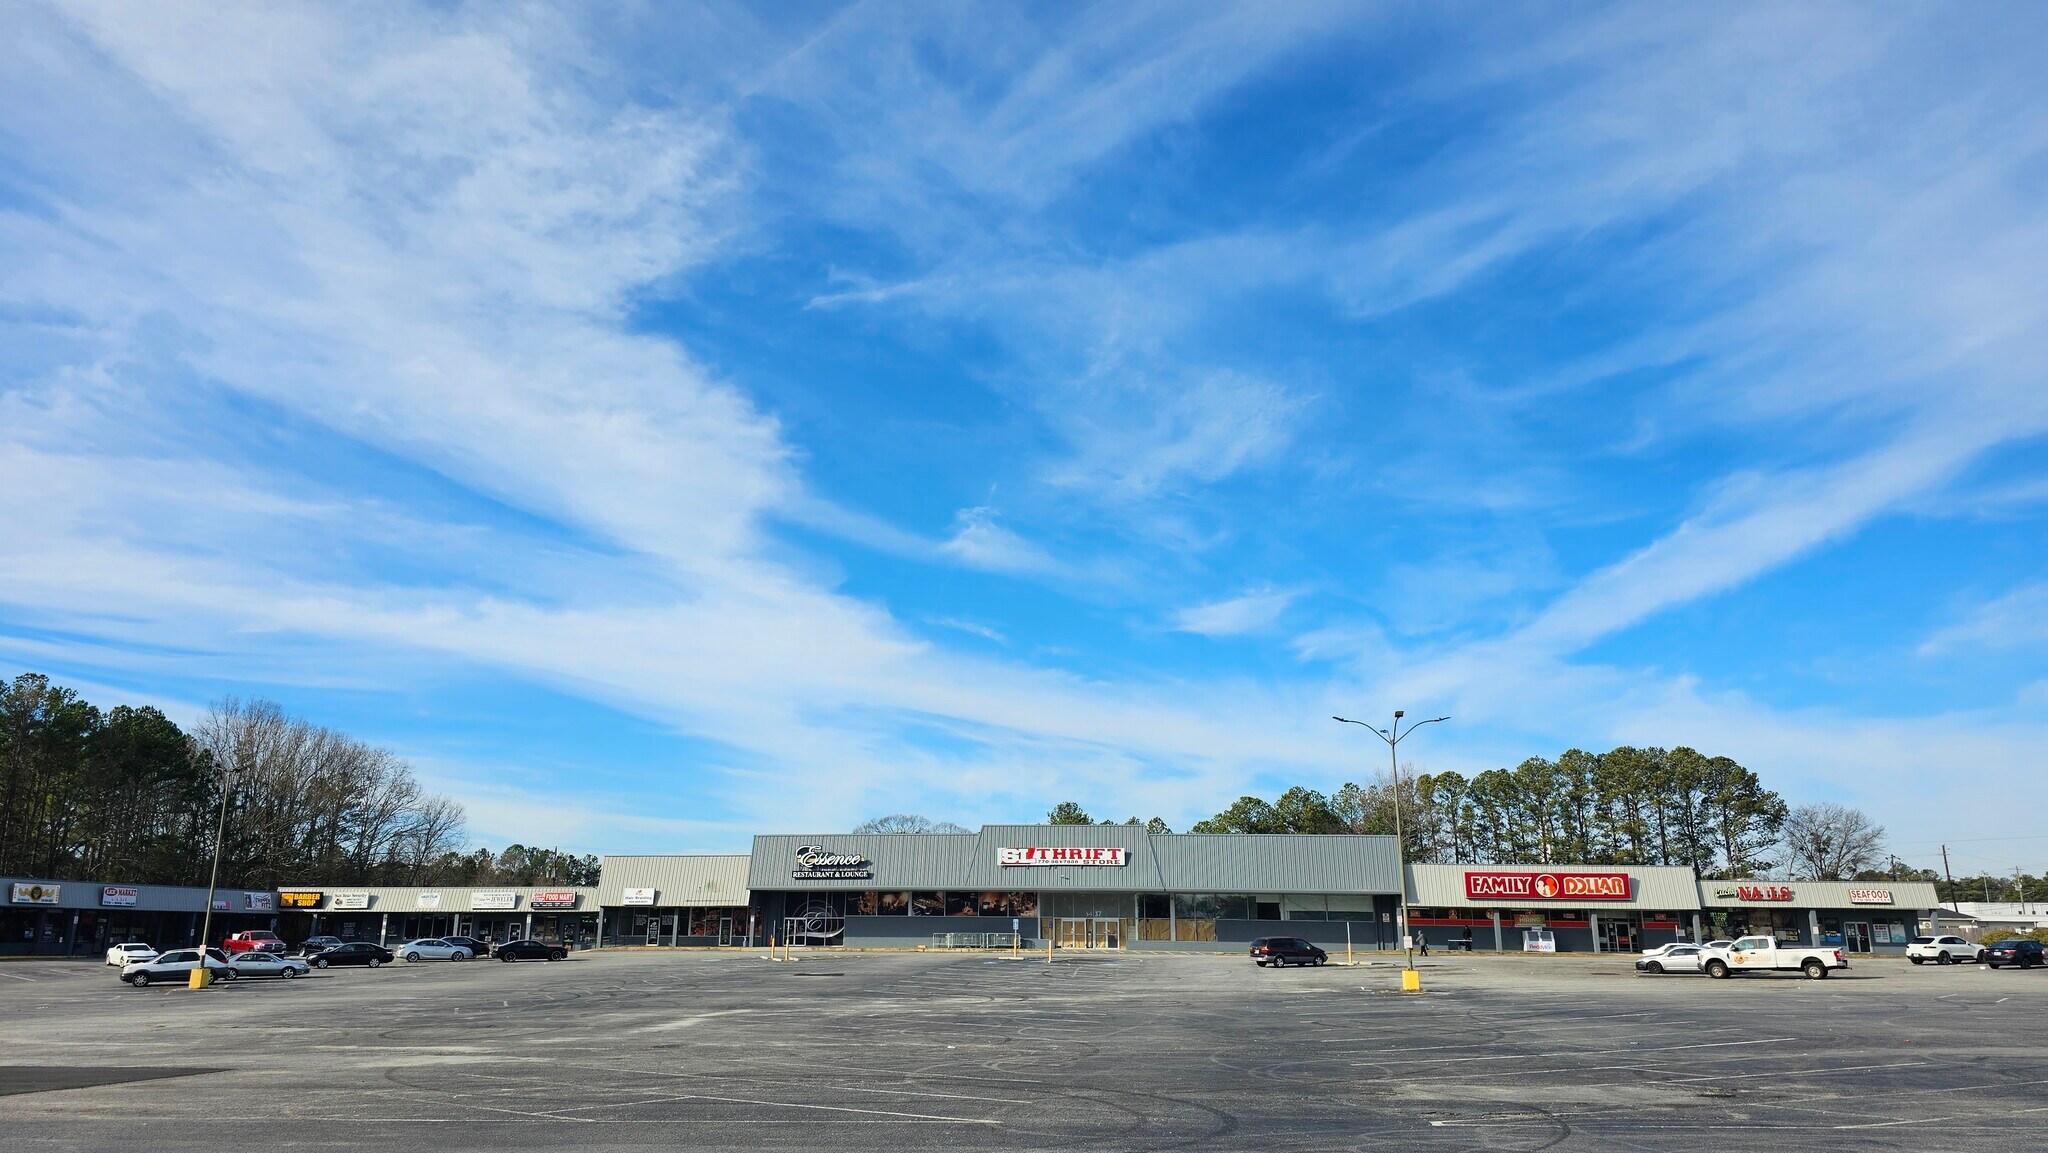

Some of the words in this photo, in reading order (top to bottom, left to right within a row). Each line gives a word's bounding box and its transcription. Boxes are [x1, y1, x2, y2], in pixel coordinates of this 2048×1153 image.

[796, 845, 861, 868] Essence
[1001, 848, 1035, 864] SL
[1036, 848, 1121, 860] THRIFT
[1471, 876, 1532, 895] FAMILY
[1563, 876, 1625, 895] DOLLAR
[118, 888, 137, 897] MARKET
[545, 893, 558, 901] FOOD
[559, 893, 573, 901] MART
[1738, 886, 1792, 901] NAILS
[1851, 890, 1889, 899] SEAFOOD
[297, 899, 316, 907] SHOP
